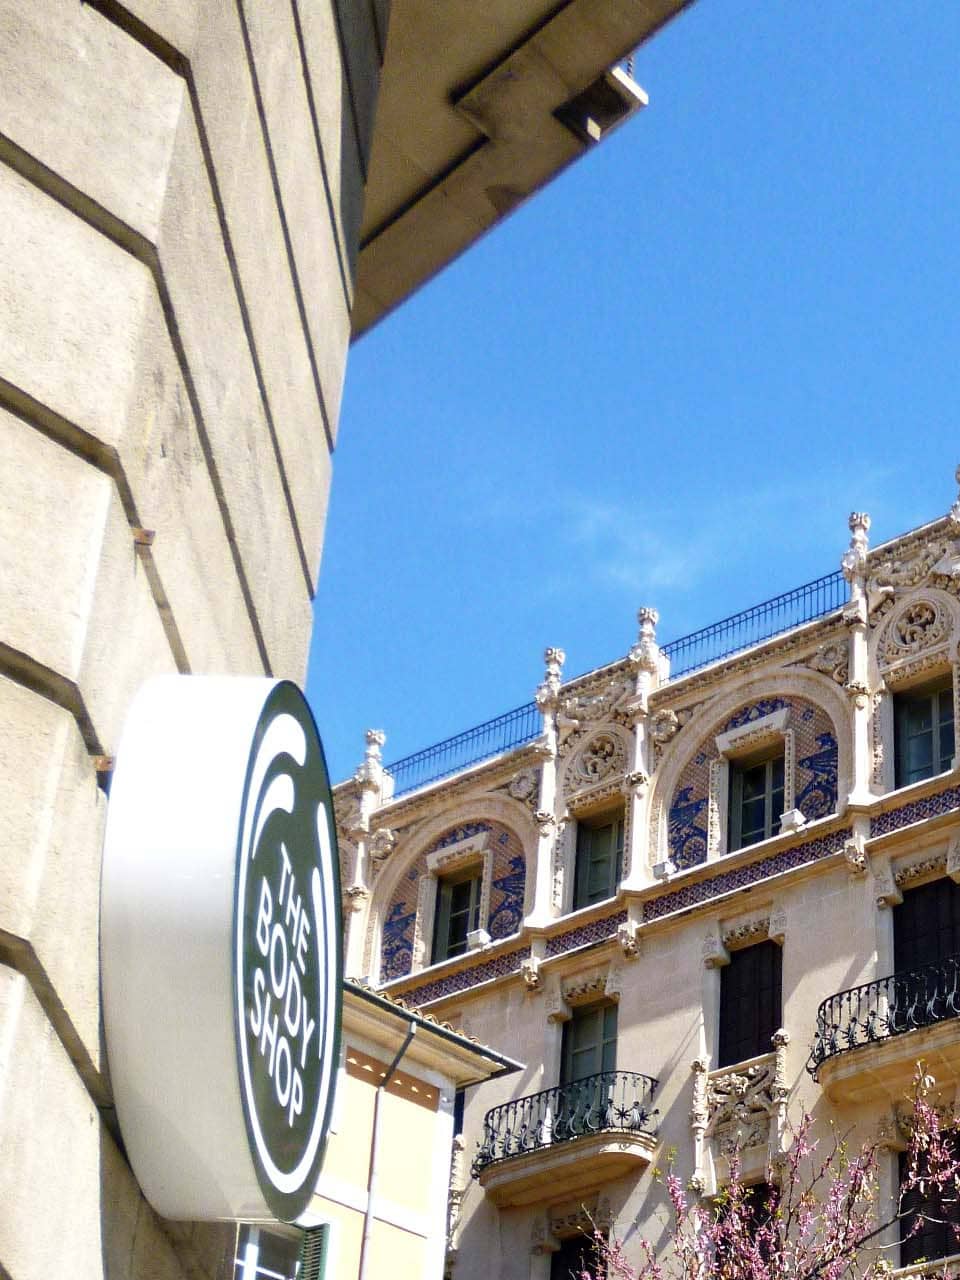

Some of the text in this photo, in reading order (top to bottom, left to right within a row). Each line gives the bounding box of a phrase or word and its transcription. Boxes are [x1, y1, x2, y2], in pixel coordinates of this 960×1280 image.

[256, 876, 315, 1070] BODY
[278, 841, 312, 975] THE
[250, 967, 304, 1128] SHOP
